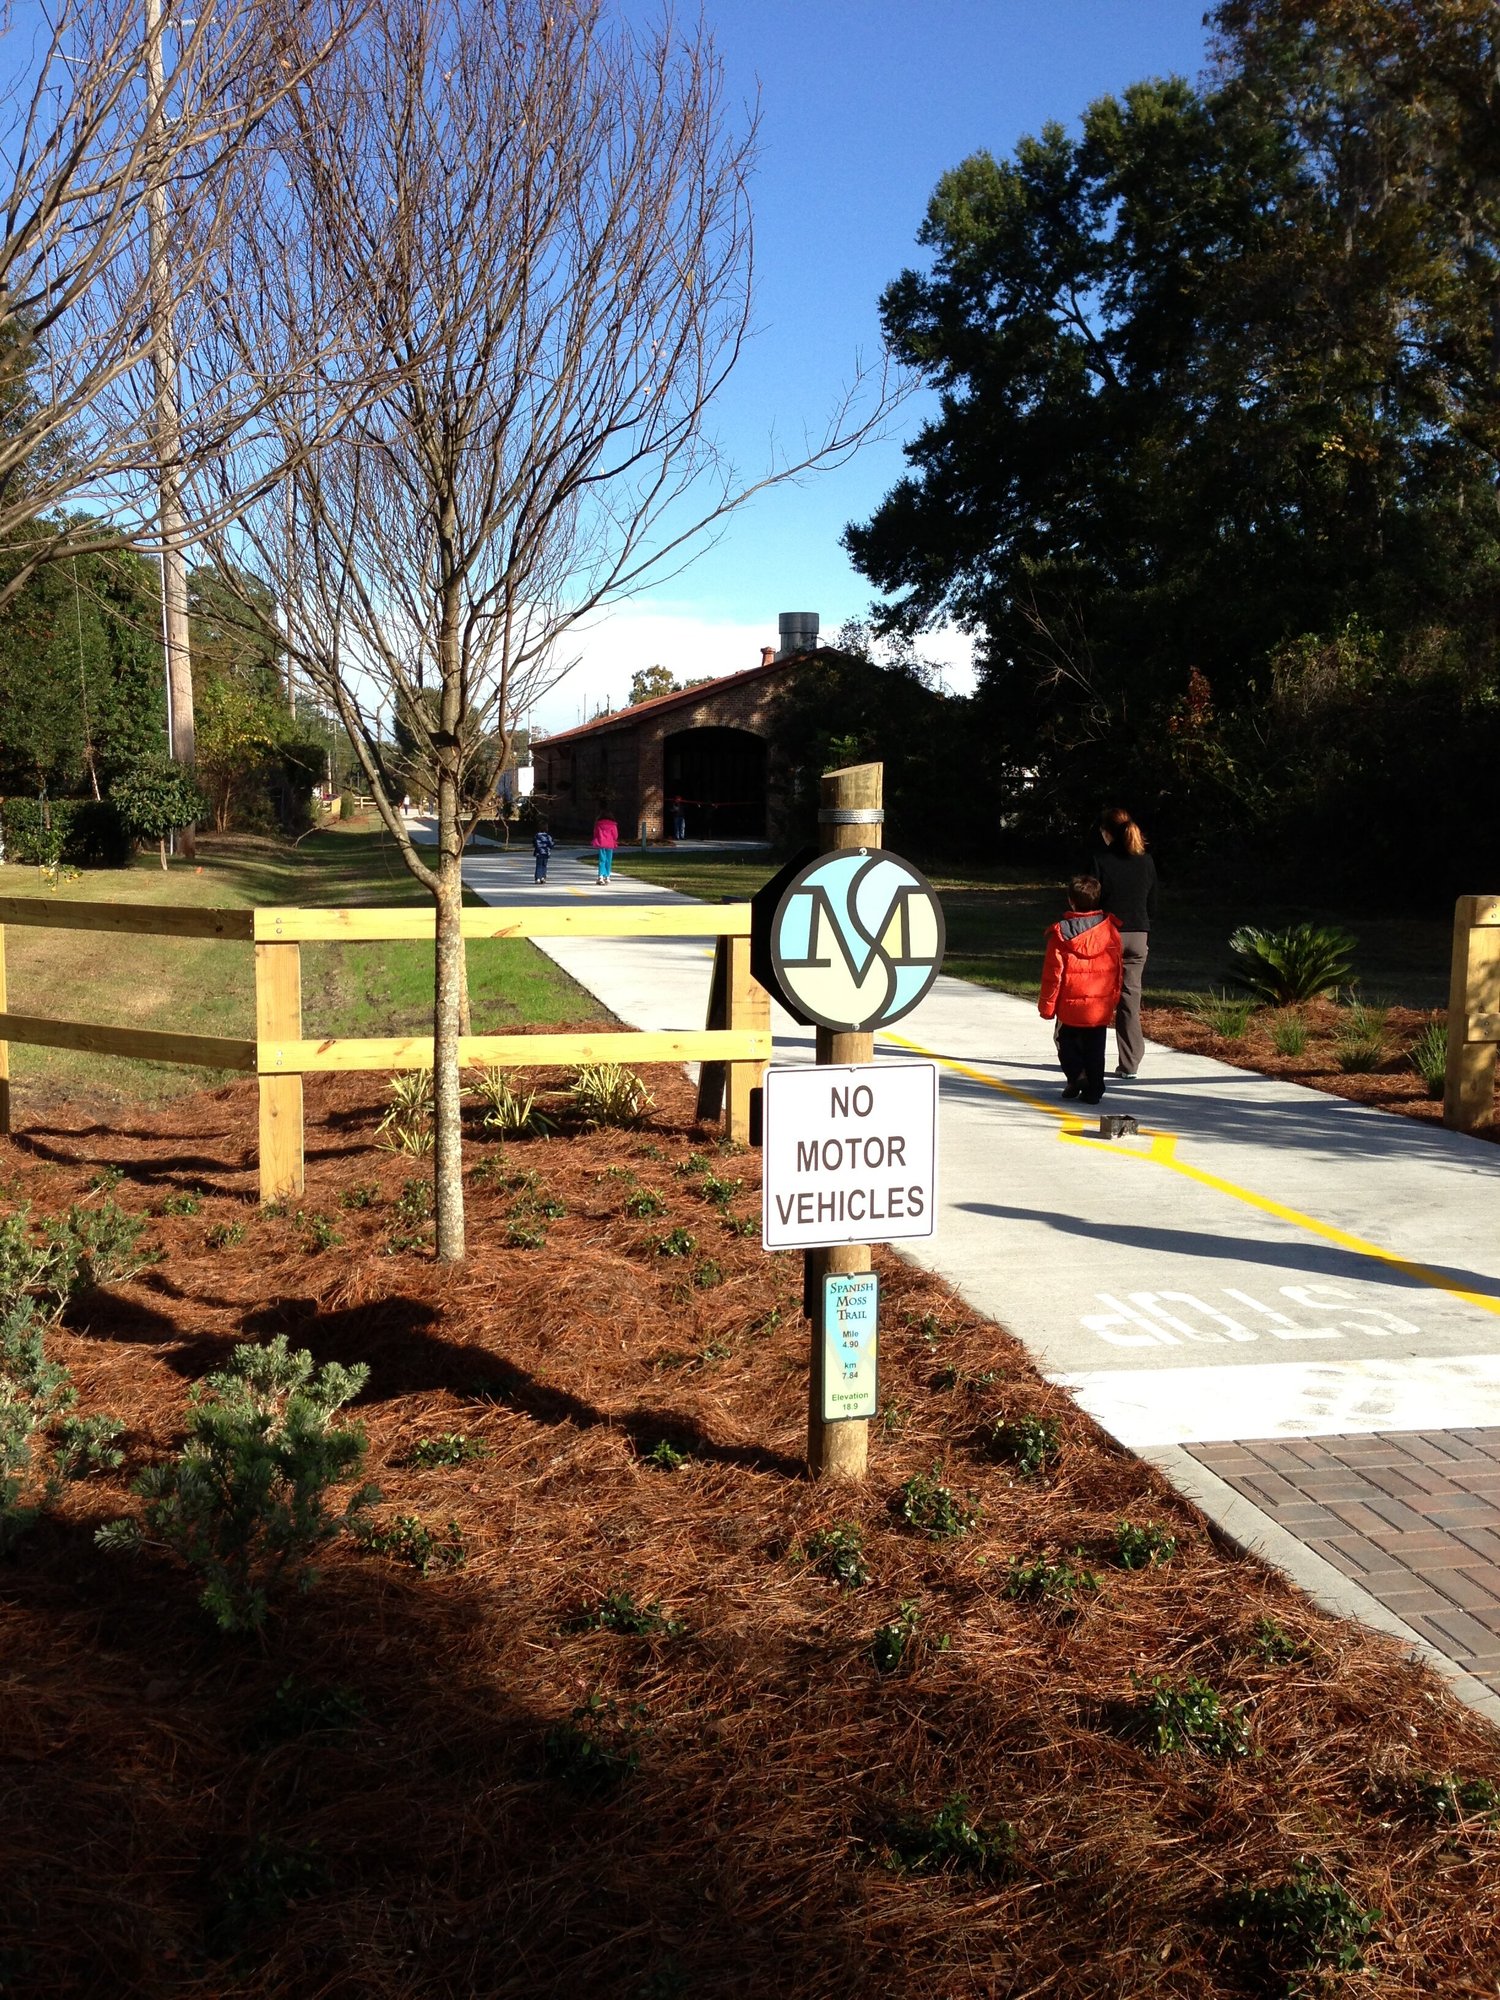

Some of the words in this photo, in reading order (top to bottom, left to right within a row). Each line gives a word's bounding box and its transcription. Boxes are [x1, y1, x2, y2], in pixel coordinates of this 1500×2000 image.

[831, 1085, 874, 1118] NO
[797, 1136, 906, 1172] MOTOR
[775, 1186, 924, 1225] VEHICLES
[830, 1282, 874, 1294] SPANISH
[836, 1296, 867, 1307] MOSS
[836, 1308, 867, 1320] TRAIL
[1080, 1284, 1421, 1347] STOP
[842, 1330, 859, 1338] Mile
[842, 1340, 859, 1348] 4.90
[842, 1371, 859, 1380] 7.84
[831, 1392, 869, 1402] Elevation
[843, 1403, 859, 1411] 18.9
